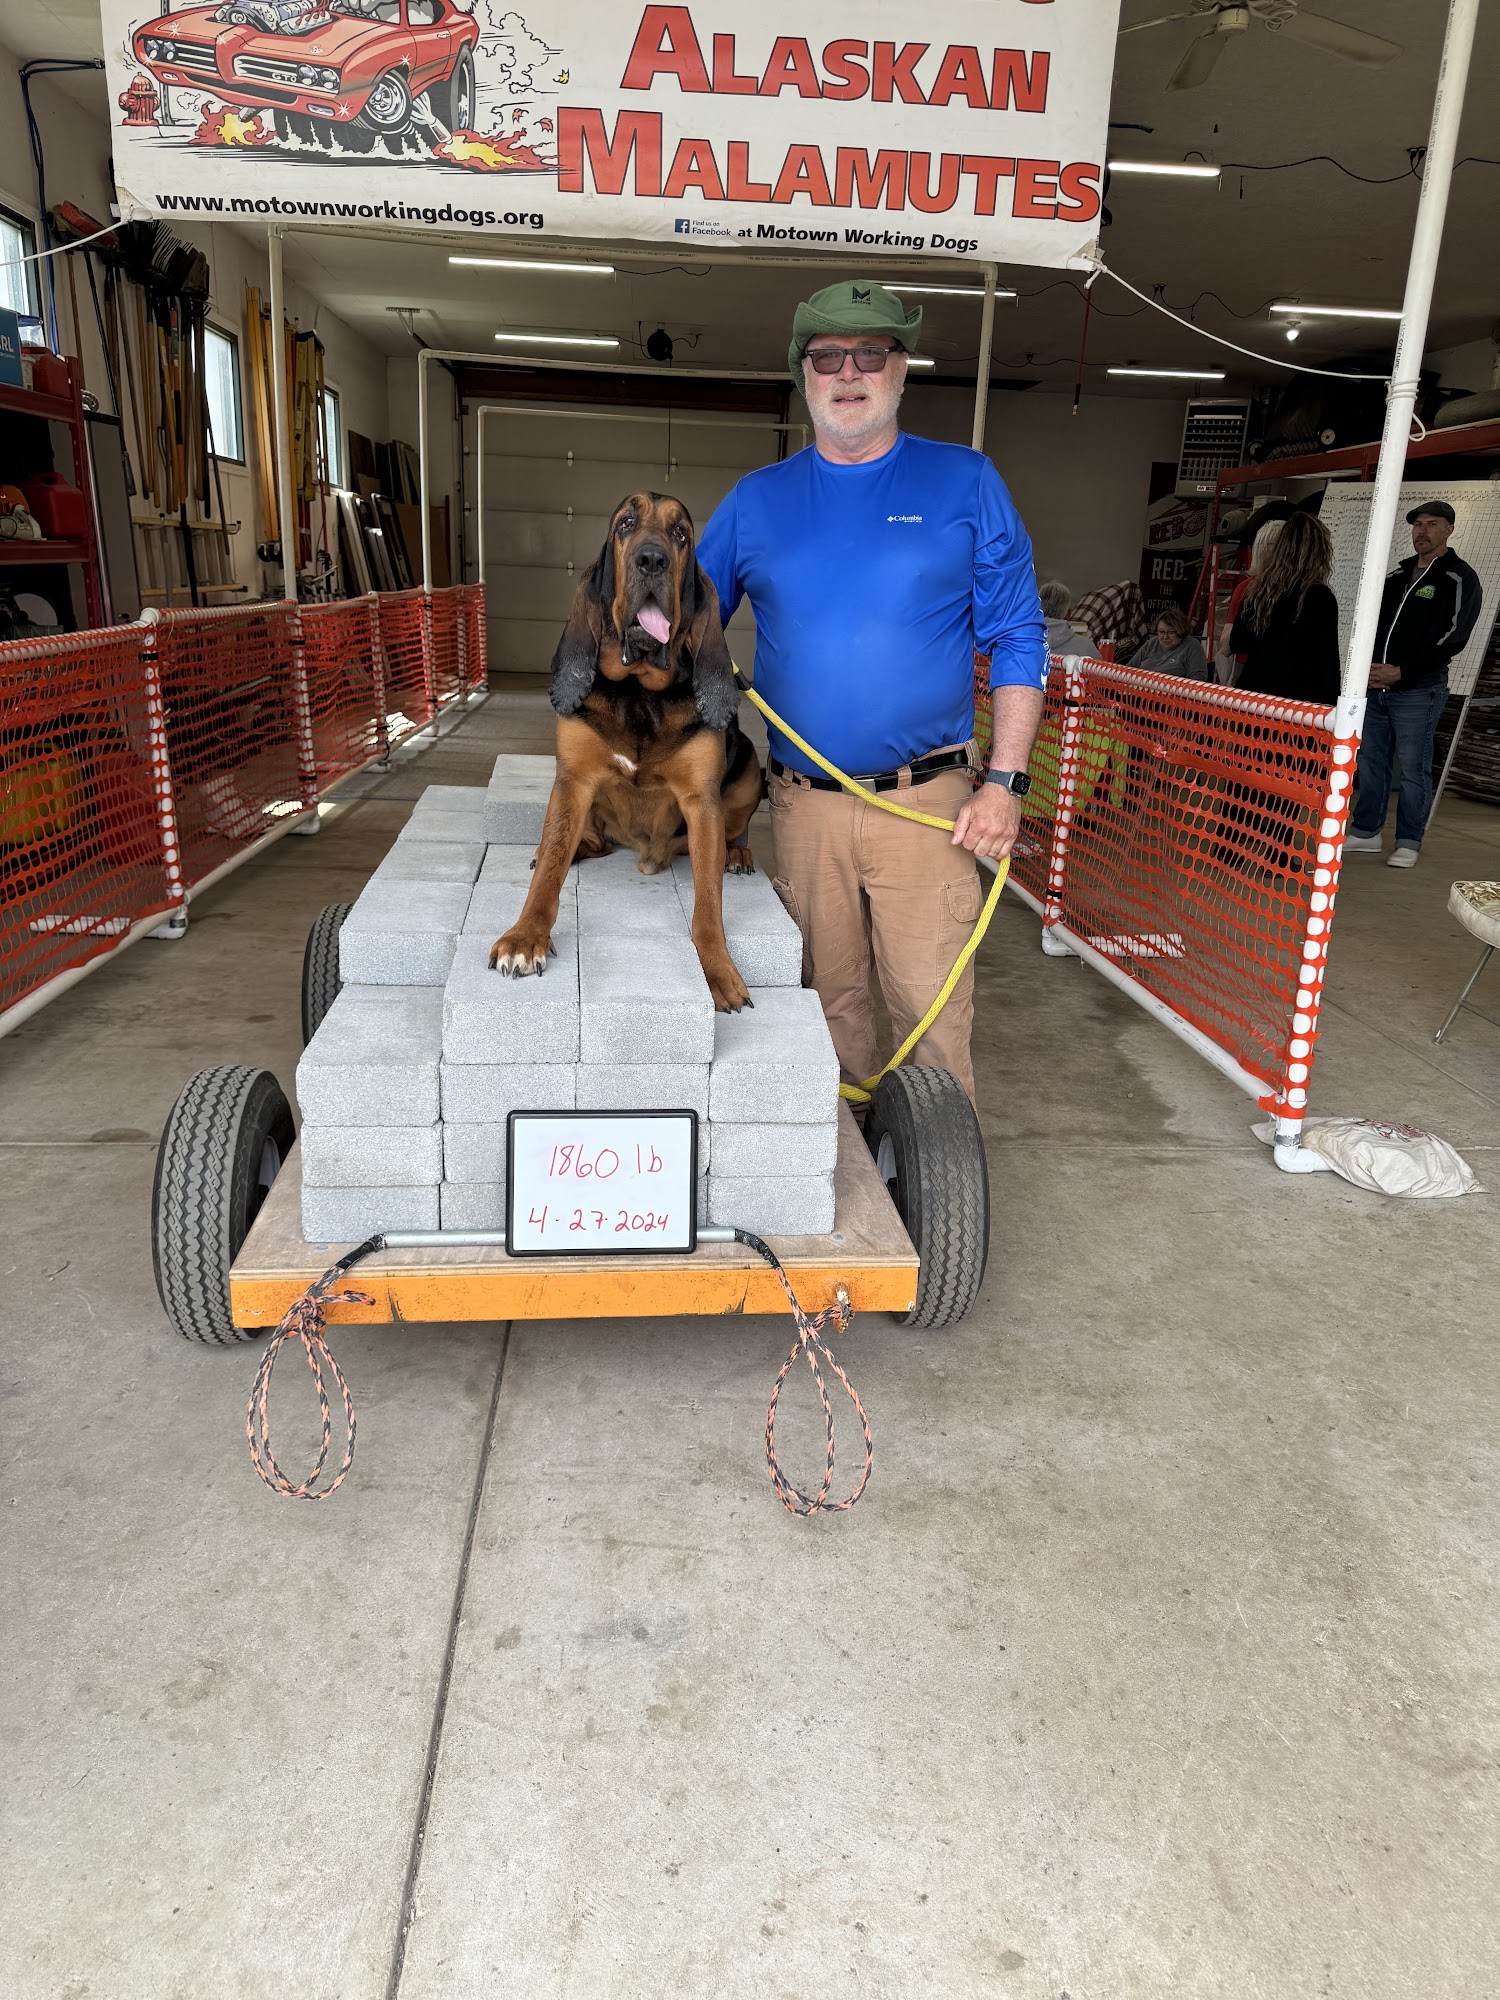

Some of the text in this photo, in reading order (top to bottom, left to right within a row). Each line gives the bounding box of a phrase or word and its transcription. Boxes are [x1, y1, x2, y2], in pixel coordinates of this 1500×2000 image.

[619, 4, 1051, 114] ALASKAN
[557, 106, 1101, 223] MALAMUTES
[155, 194, 544, 229] www.motownworkingdogs.org
[692, 224, 979, 253] Facebook at Motown Working Dogs
[0, 335, 14, 352] RL
[1159, 584, 1174, 596] THE
[549, 1143, 663, 1179] 1860 lb
